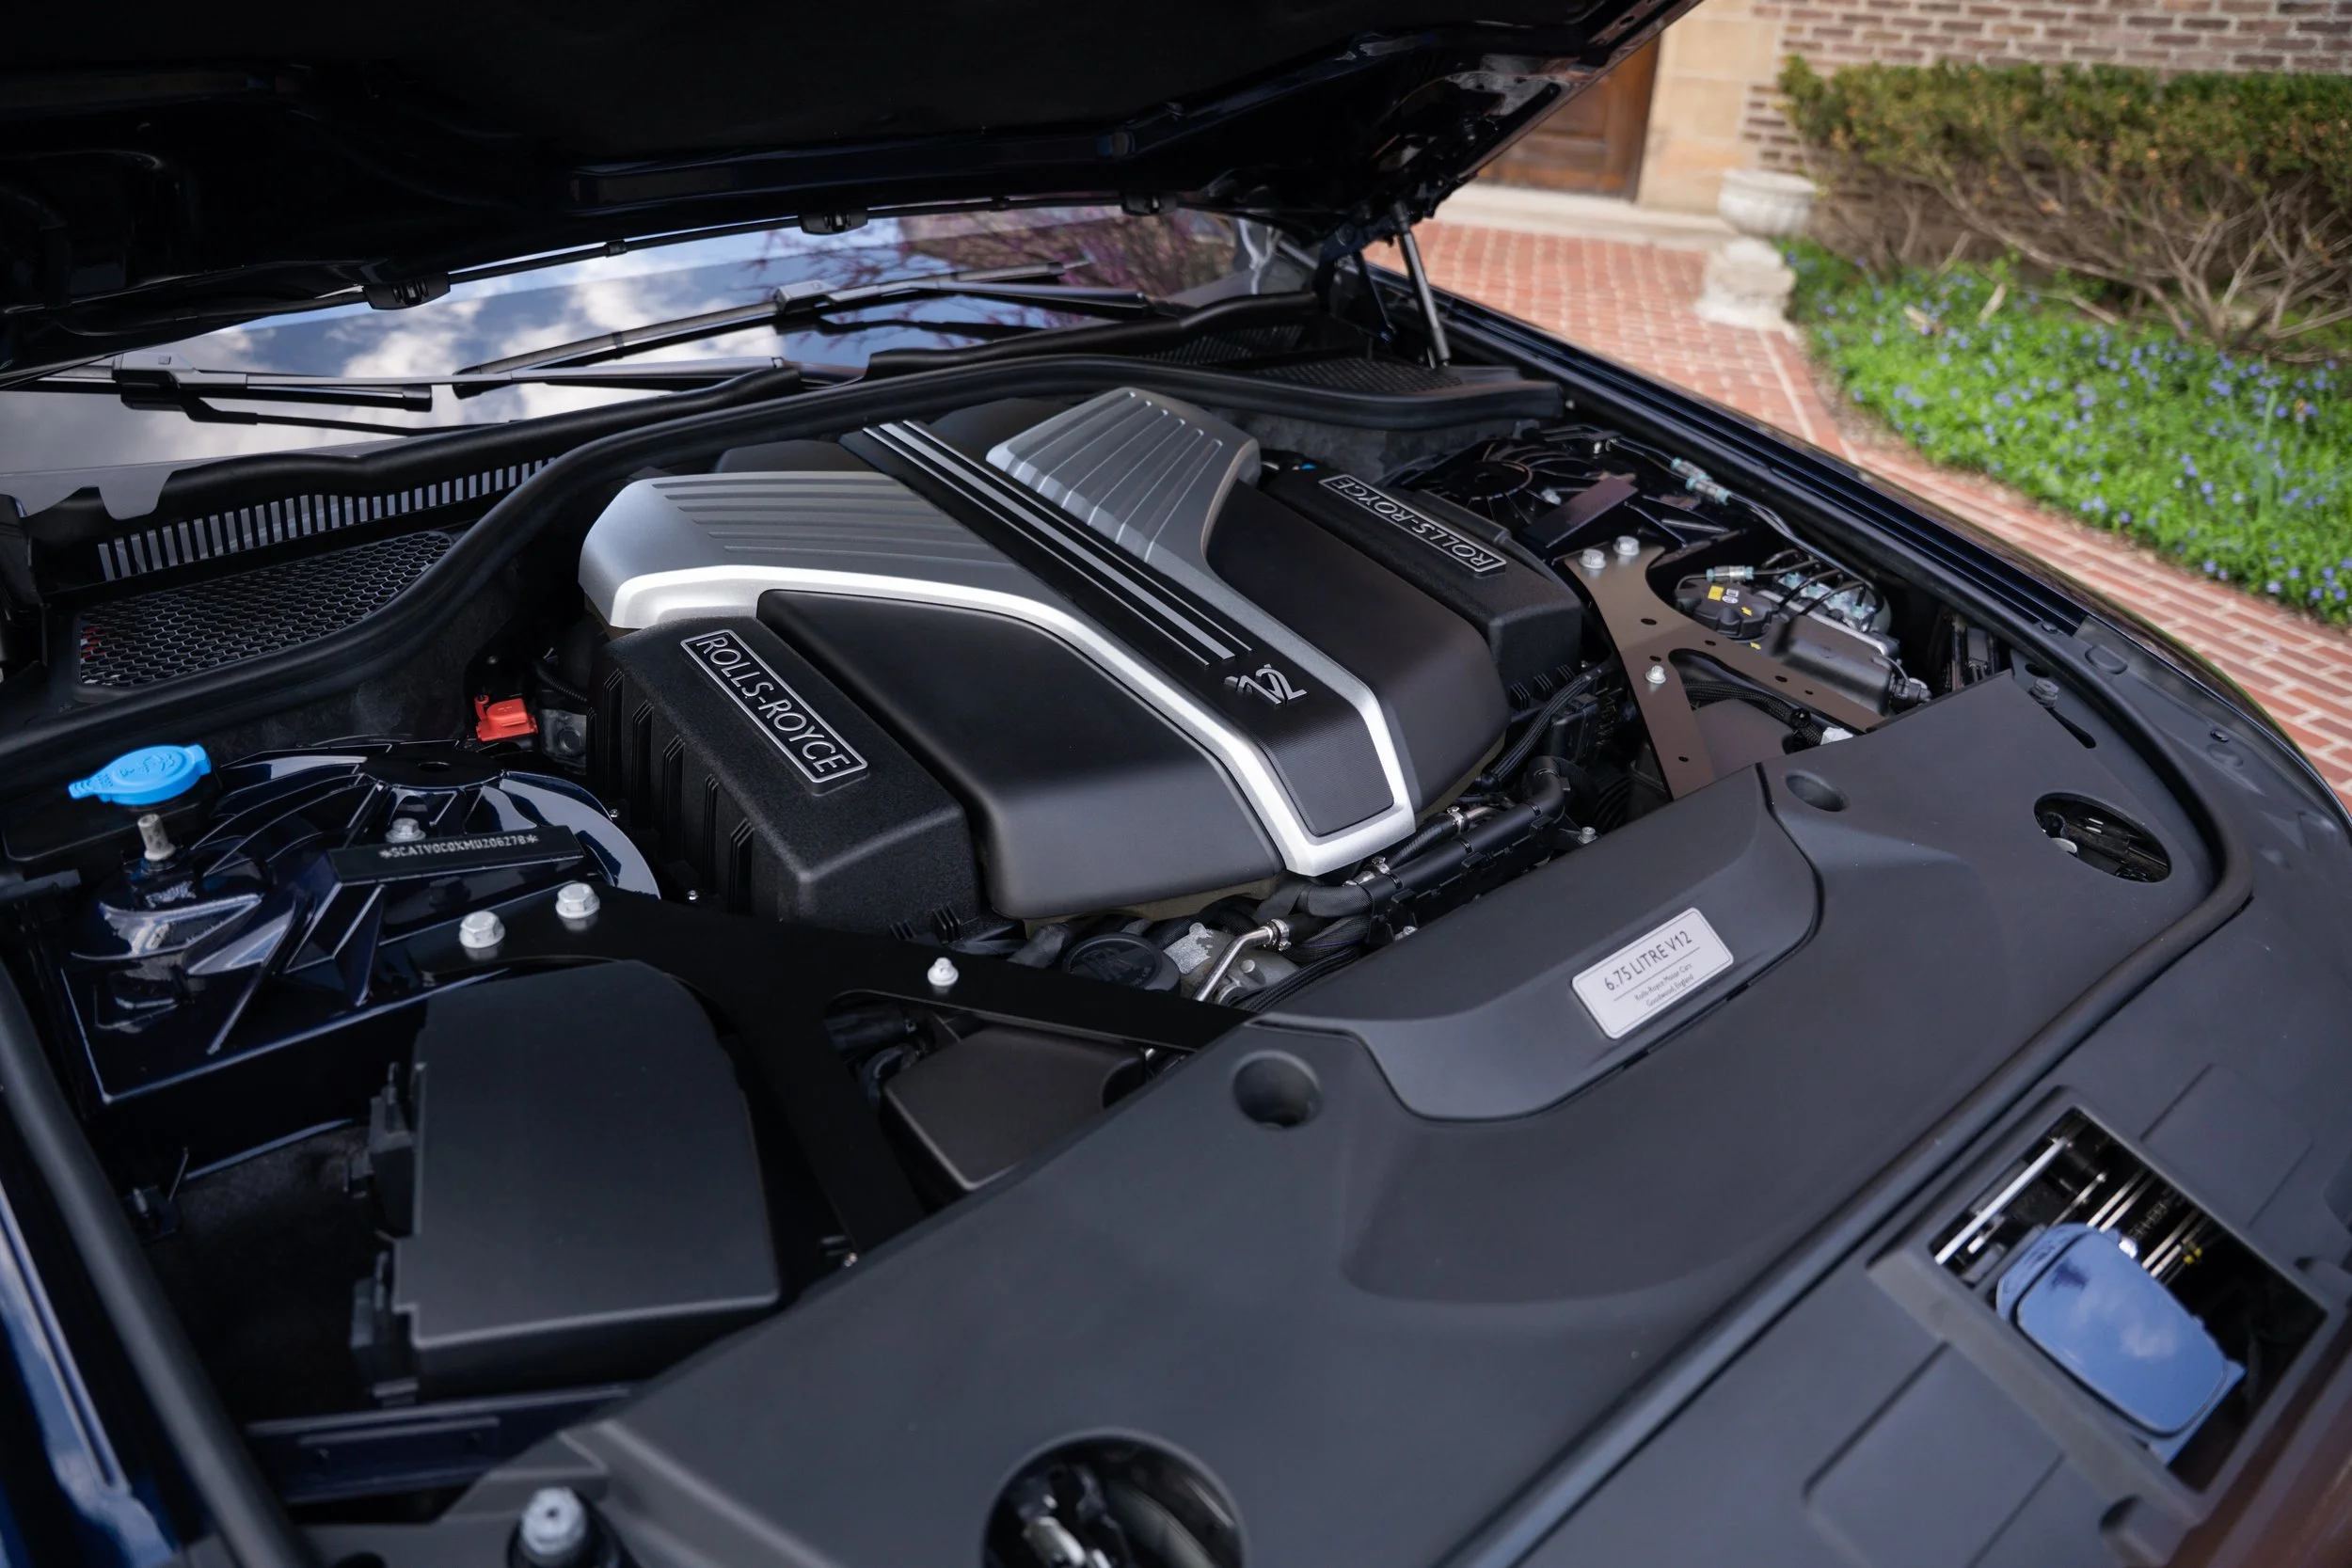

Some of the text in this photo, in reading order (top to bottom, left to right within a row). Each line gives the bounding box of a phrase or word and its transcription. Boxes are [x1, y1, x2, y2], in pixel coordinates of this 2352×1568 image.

[1331, 476, 1496, 567] ROLLS-ROYCE
[696, 636, 850, 773] ROLLS-ROYCE
[1603, 930, 1693, 991] 6.75 LITRE V12
